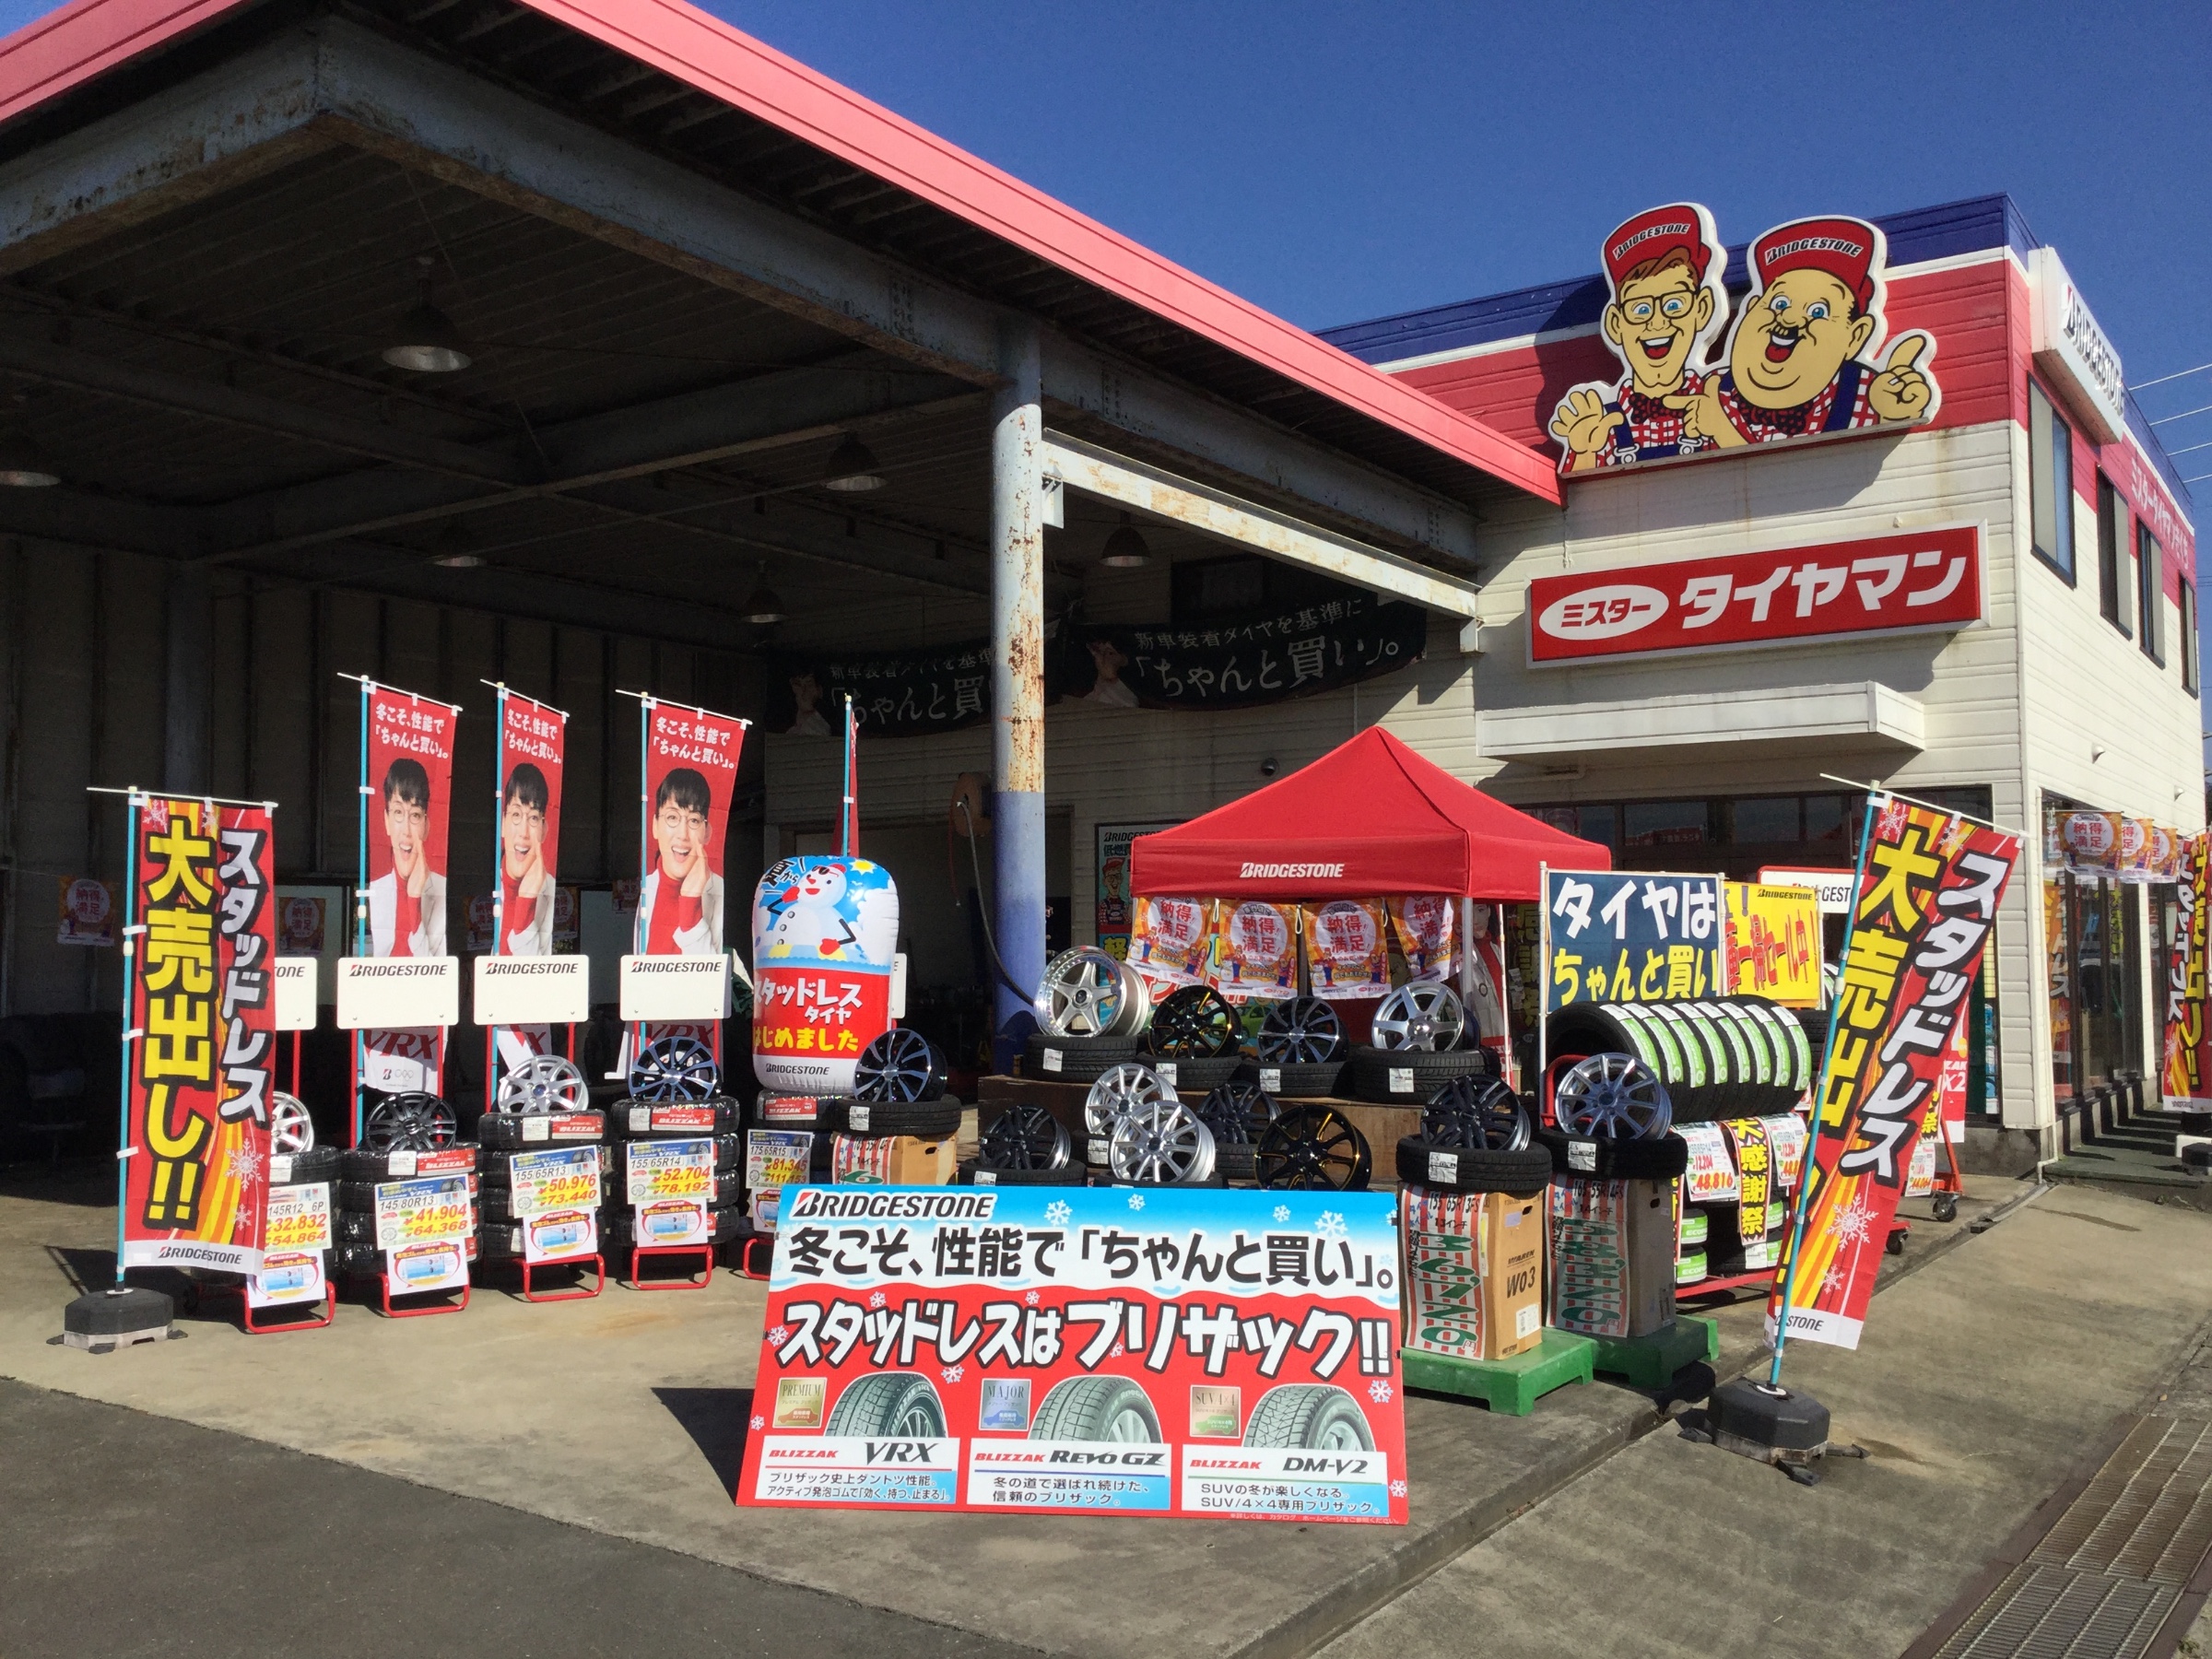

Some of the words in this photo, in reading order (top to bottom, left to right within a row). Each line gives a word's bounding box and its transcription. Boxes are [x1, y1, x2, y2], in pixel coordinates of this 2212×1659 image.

[1612, 223, 1691, 261] BRIDGESTONE
[1764, 237, 1865, 265] BRIDGESTONE
[1559, 598, 1653, 629] ミスター
[1678, 550, 1968, 630] タイヤマン
[1134, 598, 1363, 650] 新車装着タイヤを基準に
[1134, 634, 1399, 698] 「ちゃんと買い」。
[375, 701, 445, 735] 冬こそ、性能で
[506, 708, 559, 741] 冬こそ、性能で
[375, 726, 449, 760] 「ちゃんと買い」。
[655, 715, 731, 747] 冬こそ、性能で
[504, 728, 562, 764] 「ちゃんと買い」。
[652, 737, 735, 771] 「ちゃんと買い」。
[1240, 862, 1345, 878] BRIDGESTONE
[1757, 888, 1813, 901] BRIDGESTONE
[1551, 877, 1716, 940] タイヤは
[219, 830, 268, 1125] スタッドレス
[348, 963, 449, 979] BRIDGESTONE
[485, 961, 579, 976] BRIDGESTONE
[629, 960, 722, 974] BRIDGESTONE
[1553, 945, 1718, 1006] ちゃんと買い
[804, 1005, 853, 1026] タイヤ
[1841, 852, 2011, 1181] スタッドレス
[765, 1063, 830, 1077] BRIDGESTONE
[1727, 1118, 1768, 1235] 大感謝祭
[268, 1203, 304, 1217] 145R12
[312, 1201, 324, 1212] 6P
[792, 1192, 994, 1218] BRIDGESTONE
[158, 1244, 242, 1266] BRIDGESTONE
[788, 1227, 1394, 1289] 冬こそ、性能で「ちゃんと買い」。
[1506, 1266, 1535, 1299] W03
[777, 1297, 1394, 1379] スタッドレスはブリザック!!
[782, 1383, 821, 1397] PREMIUM
[988, 1384, 1025, 1400] MAJOR
[769, 1450, 841, 1459] BLIZZAK
[865, 1441, 940, 1465] VRX
[974, 1453, 1047, 1463] BLIZZAK
[1121, 1452, 1167, 1466] GZ
[1190, 1459, 1263, 1470] BLIZZAK
[1282, 1456, 1370, 1477] DM-V2
[770, 1472, 937, 1487] ブリザック史上ダントツ性能。
[993, 1477, 1149, 1493] 冬の道で選ばれ続けた、
[1200, 1483, 1350, 1499] SUVの冬が楽しくなる。
[767, 1485, 951, 1501] アクティブ発泡ゴムで「効く、持つ、止まる」。
[992, 1489, 1121, 1507] 信頼のブリザック。
[1200, 1497, 1381, 1514] SUV/4×4専用ブリザック。
